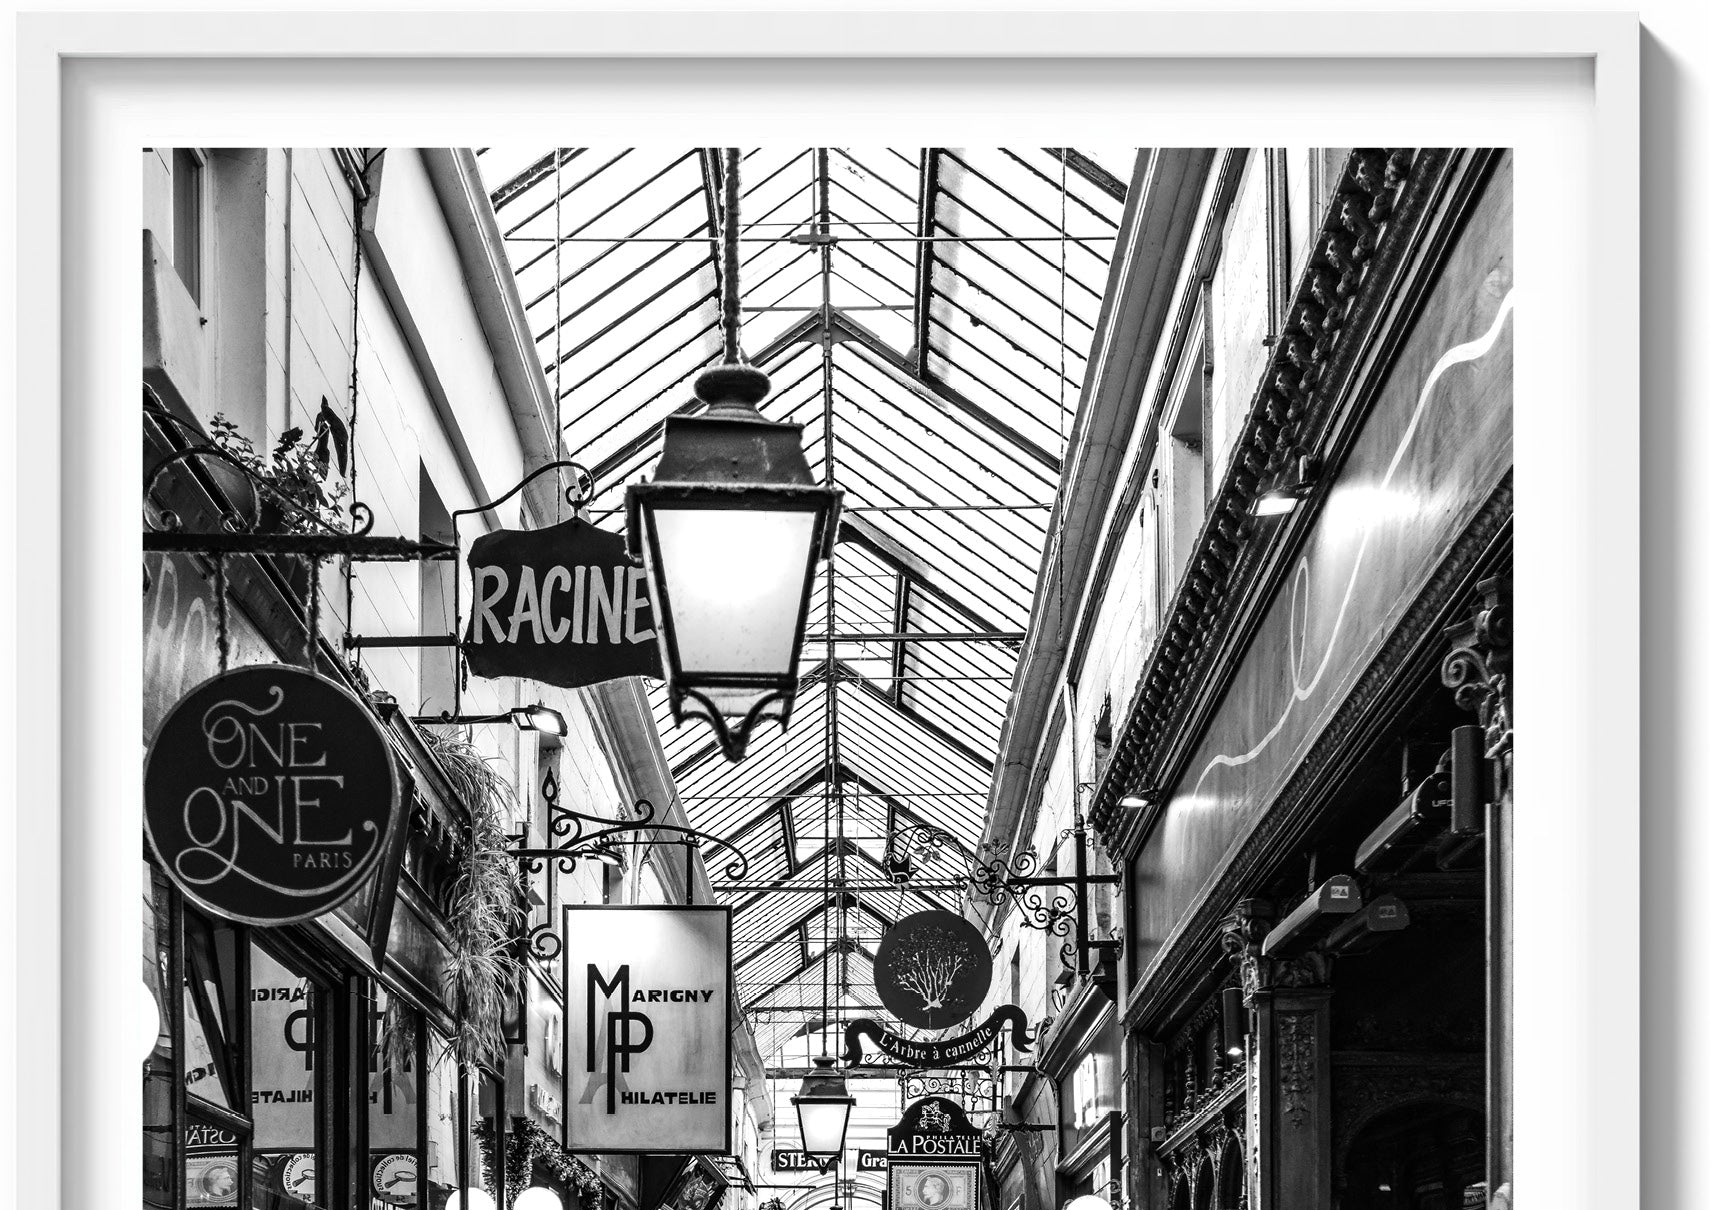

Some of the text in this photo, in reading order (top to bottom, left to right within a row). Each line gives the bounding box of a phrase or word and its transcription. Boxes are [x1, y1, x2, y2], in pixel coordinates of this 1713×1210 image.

[473, 564, 658, 645] RACINE
[203, 686, 327, 769] ONE
[221, 776, 269, 796] AND
[176, 774, 355, 886] ONE
[292, 852, 353, 869] PARIS
[879, 1027, 993, 1060] L'Arbre à cannelle
[888, 1135, 981, 1154] LA POSTALE
[905, 1185, 912, 1196] 5
